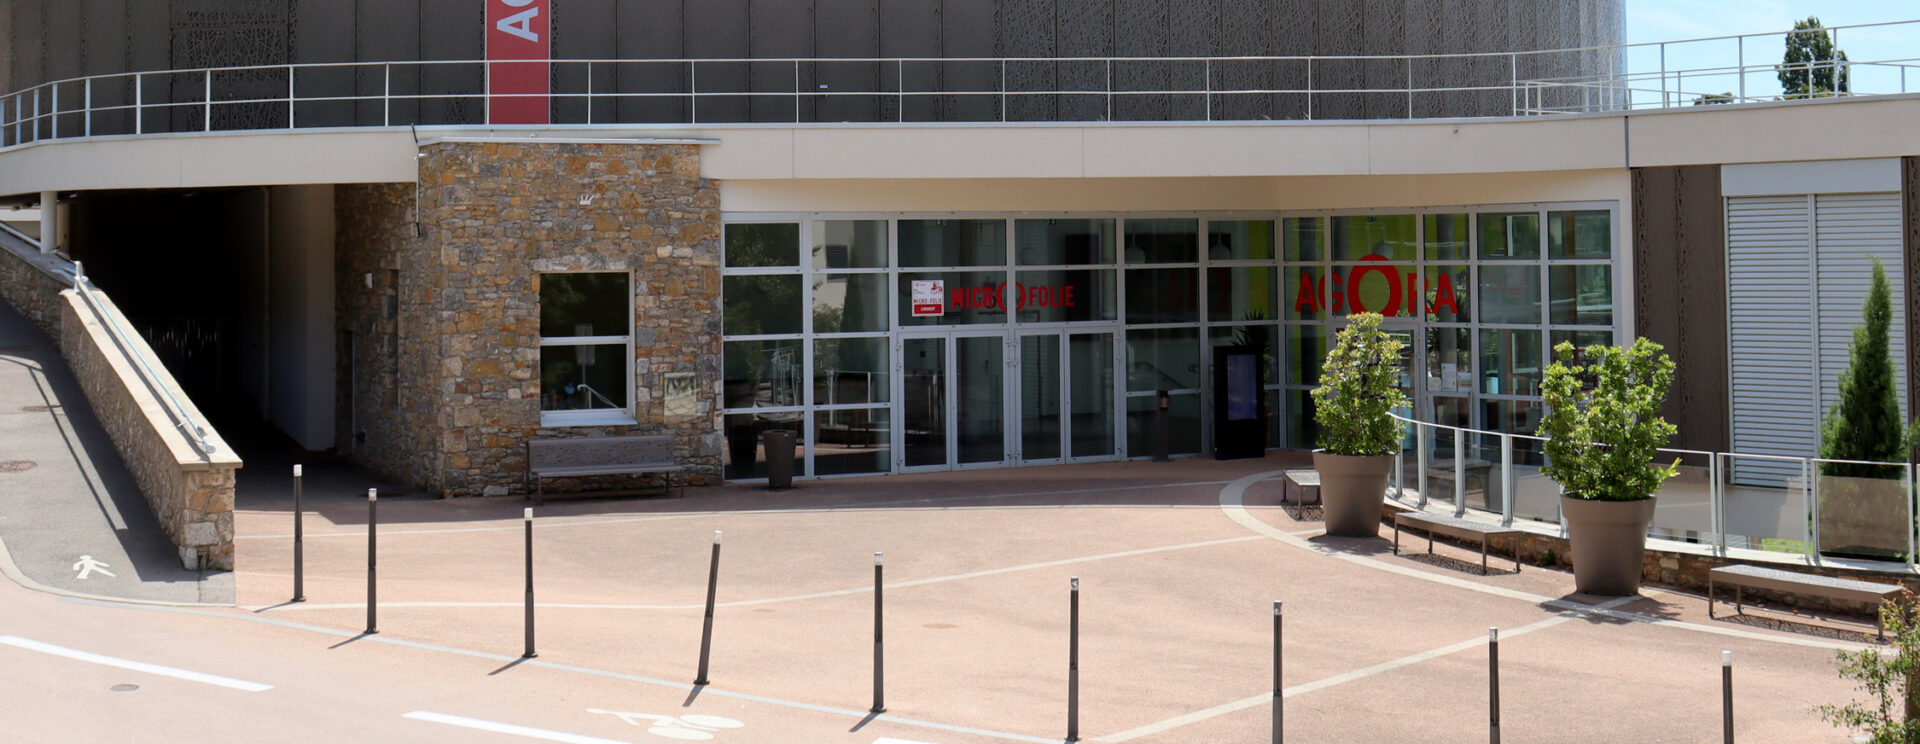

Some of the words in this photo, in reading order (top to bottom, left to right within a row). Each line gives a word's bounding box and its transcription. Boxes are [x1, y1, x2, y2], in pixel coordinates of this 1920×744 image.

[497, 0, 539, 43] A
[1029, 285, 1075, 307] FOLIE
[1294, 253, 1459, 317] AGORA
